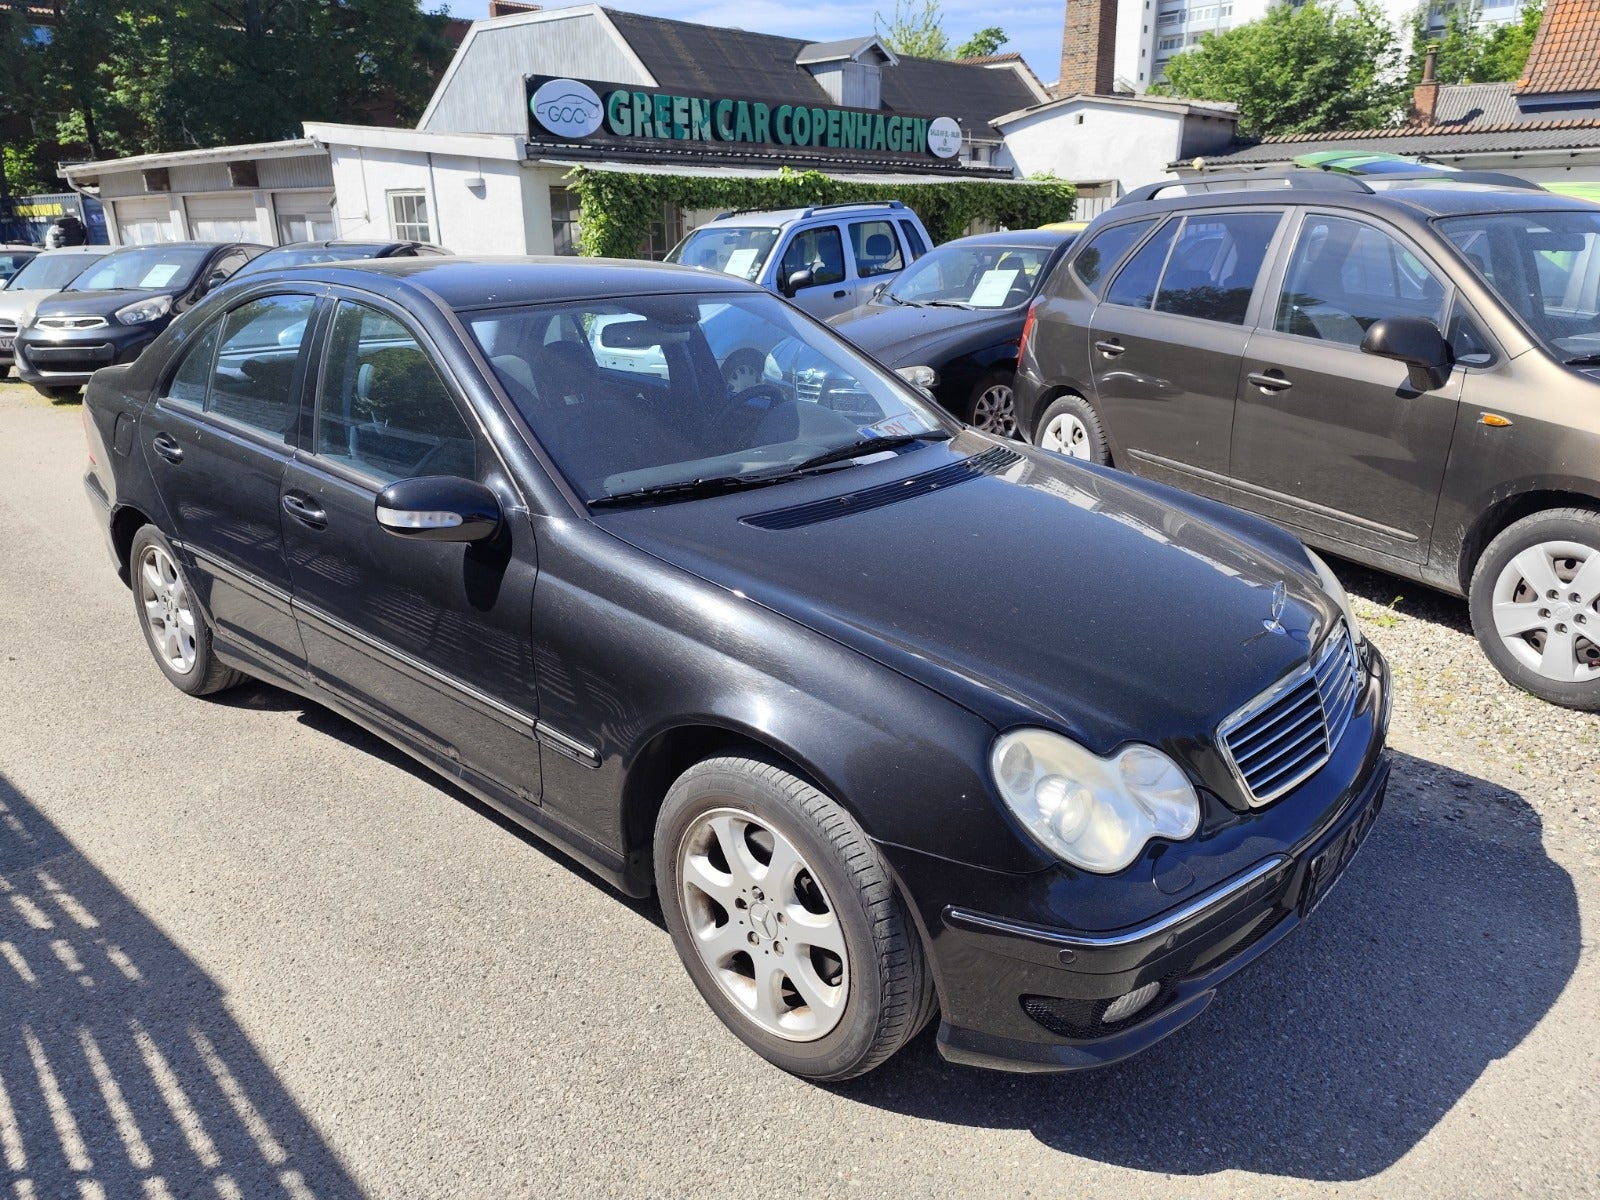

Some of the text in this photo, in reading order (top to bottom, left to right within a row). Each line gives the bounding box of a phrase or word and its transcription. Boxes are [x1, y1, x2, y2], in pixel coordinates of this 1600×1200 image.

[607, 89, 927, 153] GREEN CAR COPENHAGEN
